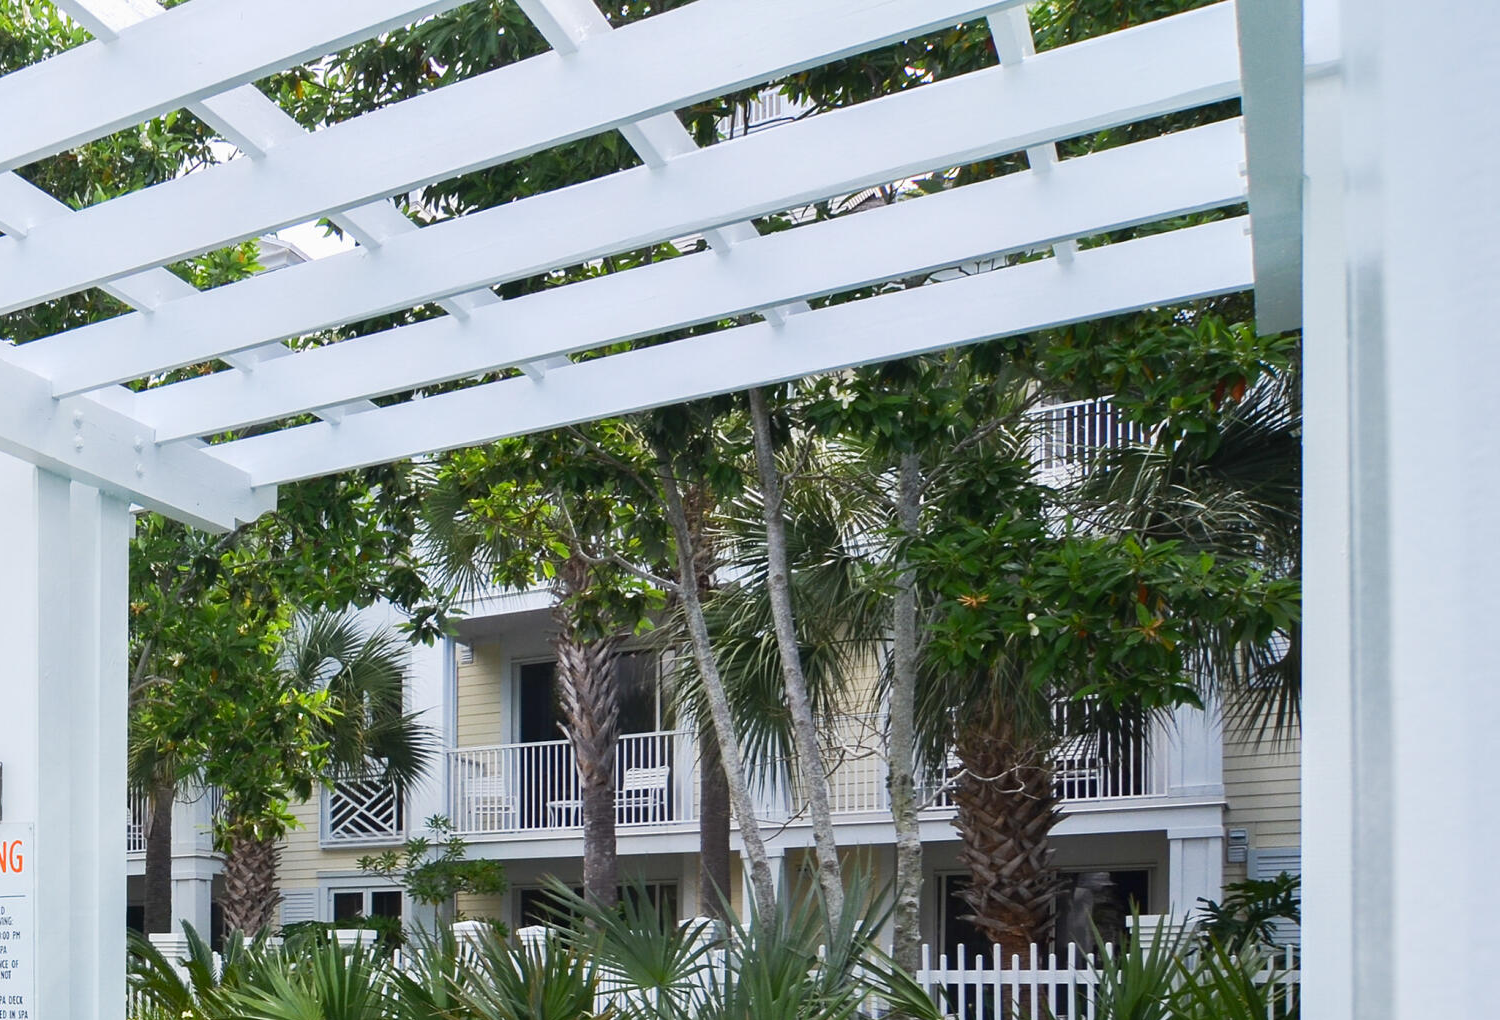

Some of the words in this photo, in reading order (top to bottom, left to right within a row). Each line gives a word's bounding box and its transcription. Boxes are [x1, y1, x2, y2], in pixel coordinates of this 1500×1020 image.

[12, 931, 21, 940] PM
[11, 960, 19, 968] OF
[1, 970, 11, 979] NOT
[8, 996, 23, 1005] DECK
[9, 1010, 16, 1019] IN
[18, 1010, 28, 1019] SPA
